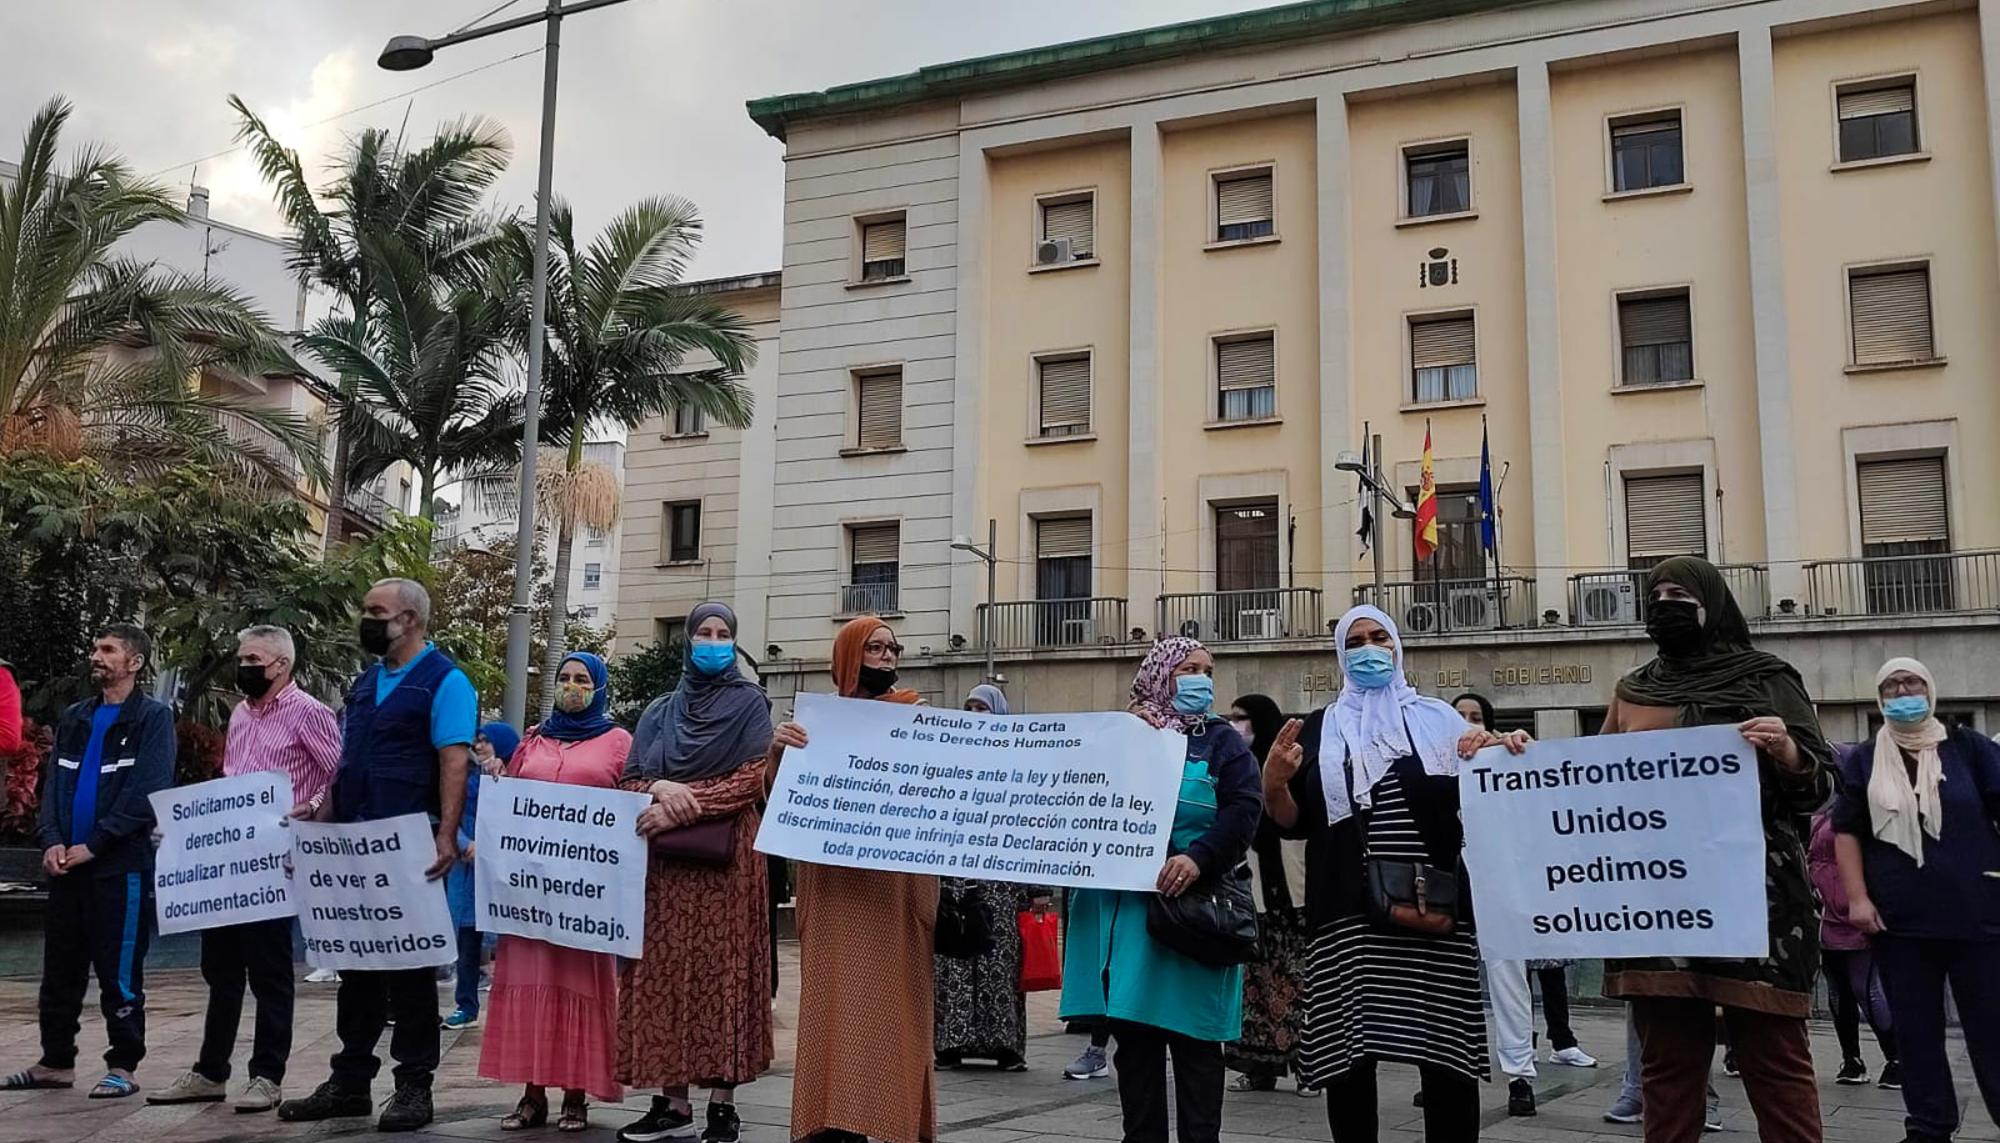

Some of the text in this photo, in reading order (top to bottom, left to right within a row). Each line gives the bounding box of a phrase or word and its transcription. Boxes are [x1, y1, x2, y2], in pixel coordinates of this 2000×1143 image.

[1437, 670, 1473, 688] DEL
[1491, 665, 1592, 686] GOBIERNO
[890, 728, 1081, 748] de los Derechos Humanos
[977, 721, 986, 731] 7
[990, 722, 1008, 732] de
[1011, 722, 1024, 732] la
[1028, 721, 1066, 732] Carta
[848, 754, 1110, 788] Todos son iguales ante la ley y tienen,
[1472, 752, 1741, 793] Transfronterizos
[172, 785, 275, 821] Solicitamos el
[797, 772, 1155, 815] sin distinción, derecho a igual protección de la ley.
[513, 796, 616, 827] Libertad de
[787, 789, 1157, 835] Todos tienen derecho a igual protección contra toda
[1552, 805, 1668, 836] Unidos
[185, 825, 256, 850] derecho a
[500, 834, 620, 865] movimientos
[777, 810, 1154, 858] discriminación que infrinja esta Declaración y contra
[157, 850, 288, 888] actualizar nuestr
[823, 840, 1096, 878] toda provocación a tal discriminación.
[1546, 856, 1688, 891] pedimos
[309, 869, 390, 889] de ver a
[509, 868, 606, 900] sin perder
[164, 884, 287, 919] documentación
[312, 903, 404, 921] nuestros
[488, 902, 630, 942] nuestro trabajo.
[1532, 904, 1714, 935] soluciones
[349, 933, 447, 958] queridos
